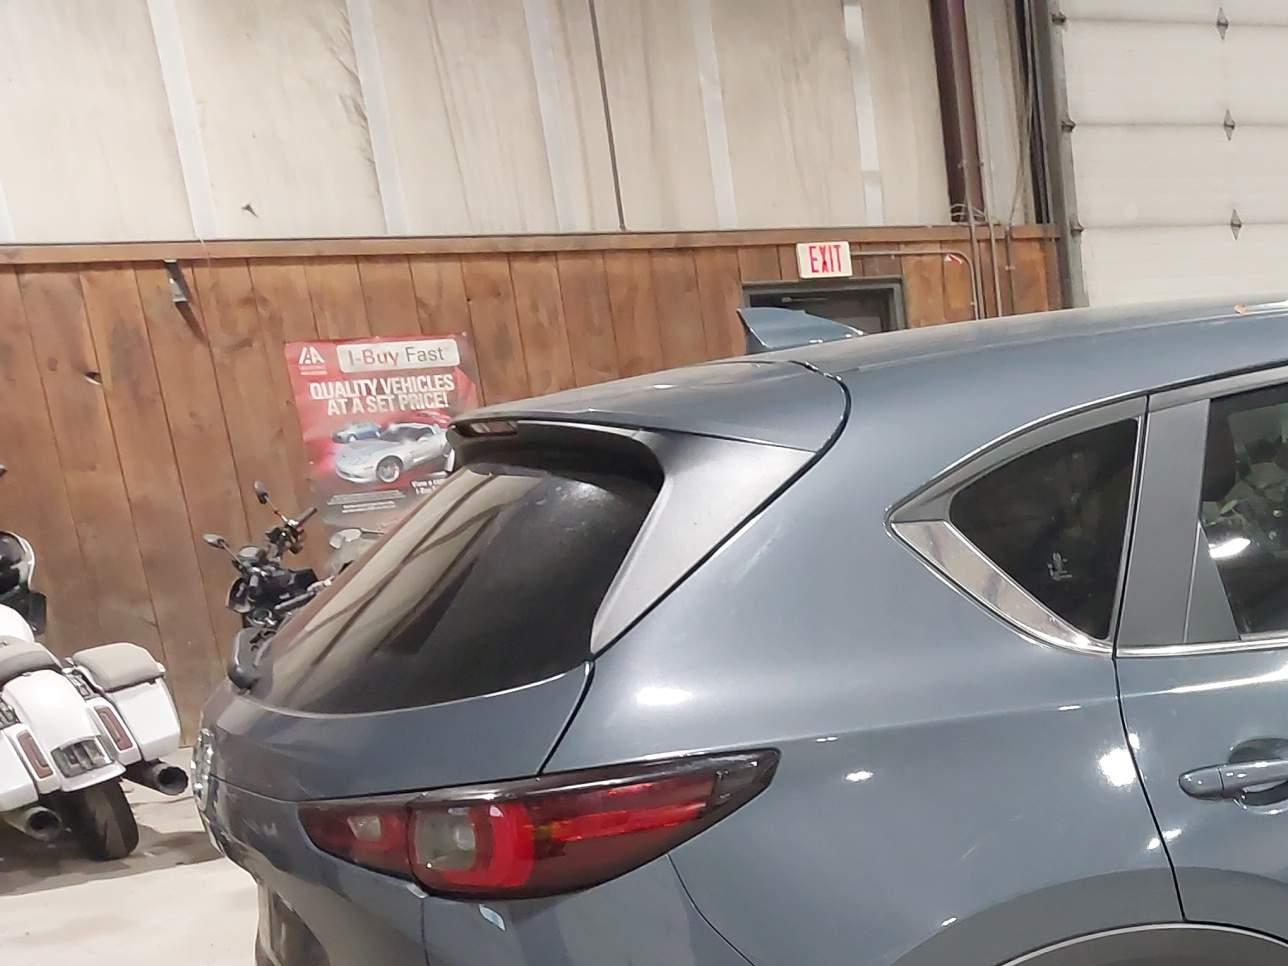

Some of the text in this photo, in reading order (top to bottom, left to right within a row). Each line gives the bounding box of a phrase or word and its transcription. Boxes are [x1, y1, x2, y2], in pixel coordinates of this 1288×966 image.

[808, 244, 842, 273] EXIT
[348, 345, 444, 366] I-Buy Fast
[310, 374, 455, 400] QUALITY VEHICLES
[327, 391, 449, 416] AT A SET PRICE!
